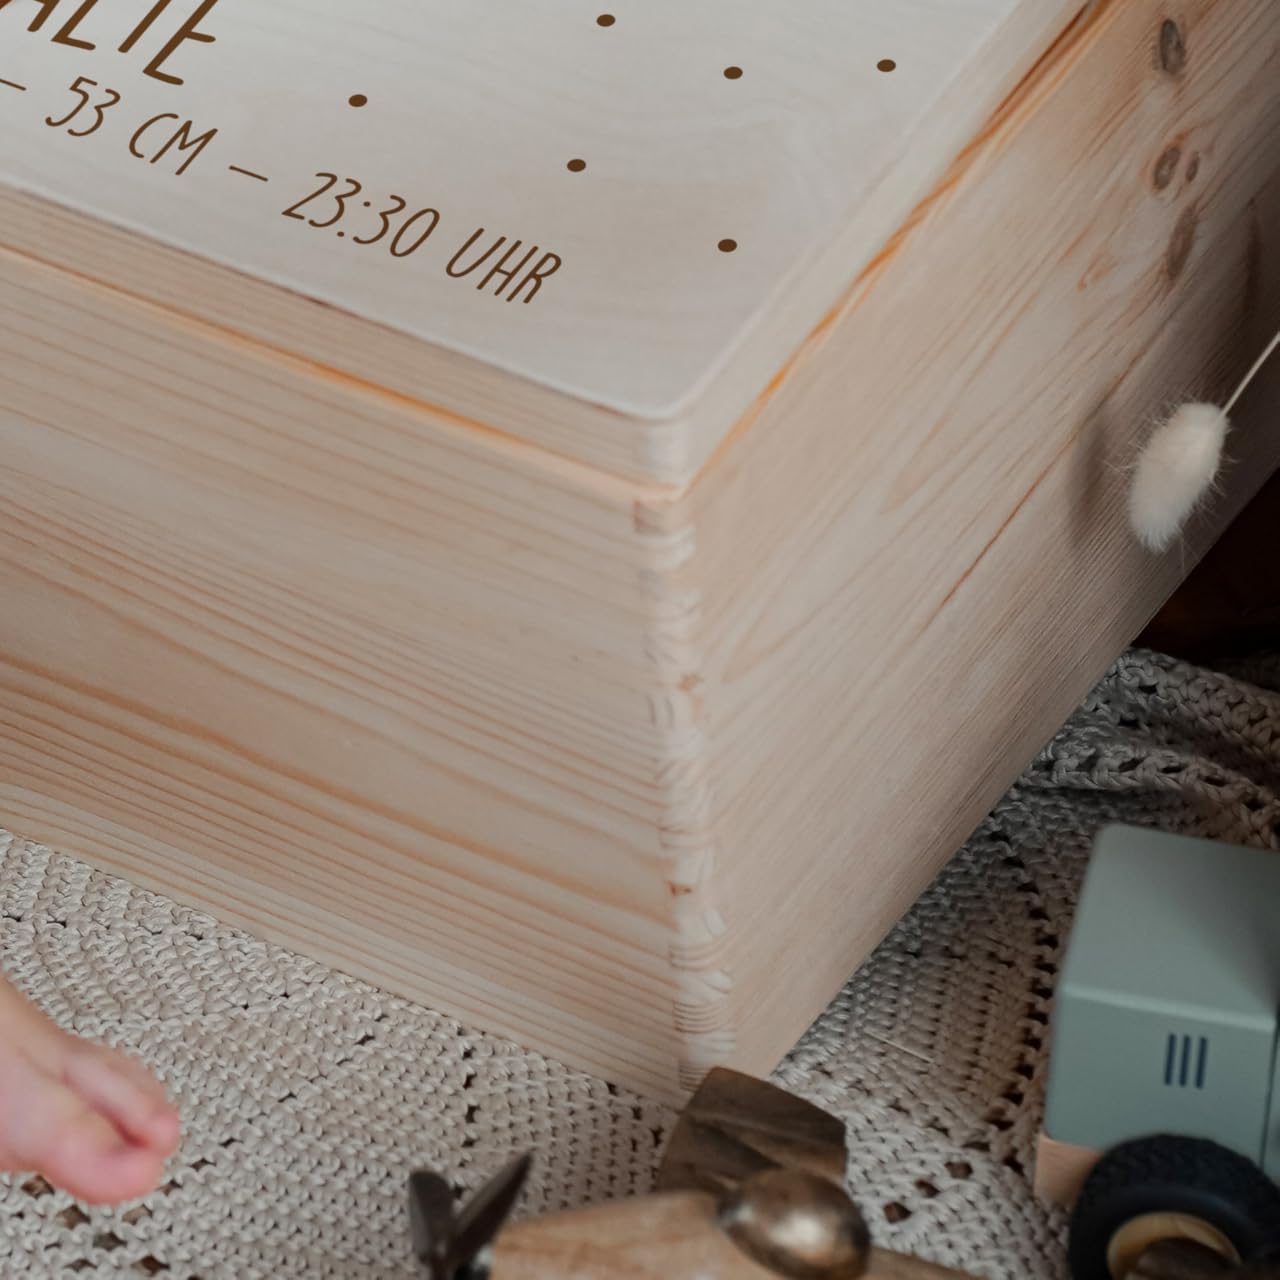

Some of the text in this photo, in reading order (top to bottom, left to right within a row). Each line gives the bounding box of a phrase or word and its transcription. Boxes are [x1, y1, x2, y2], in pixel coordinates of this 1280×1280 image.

[45, 76, 121, 137] 53
[128, 112, 219, 176] CM
[281, 172, 441, 258] 23:30
[445, 227, 563, 305] UHR
